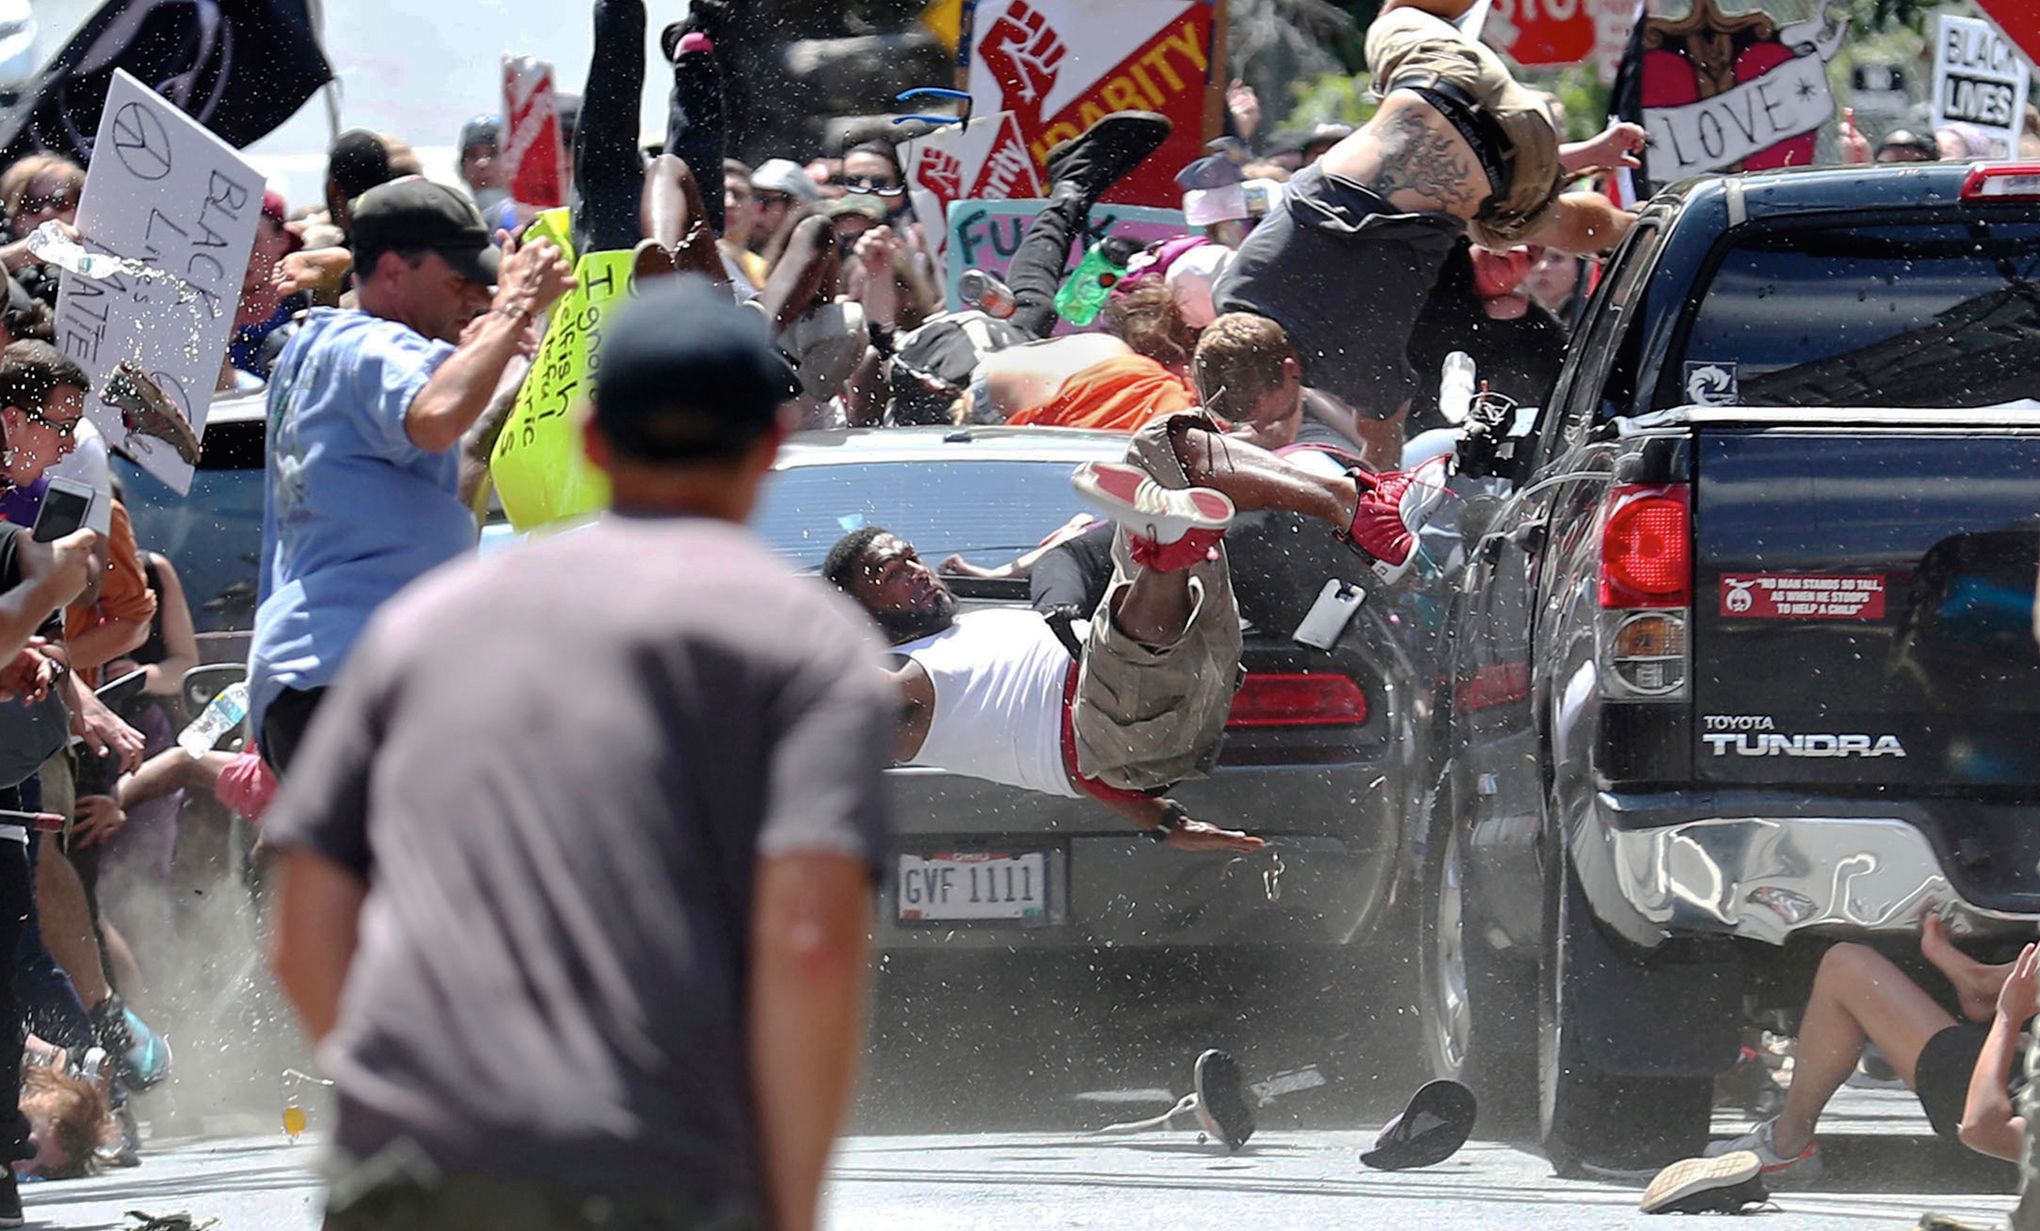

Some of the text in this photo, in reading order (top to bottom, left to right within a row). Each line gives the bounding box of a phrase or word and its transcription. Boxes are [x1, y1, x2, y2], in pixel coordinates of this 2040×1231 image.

[1944, 77, 2012, 125] LIVES
[1661, 79, 1798, 168] LOVE
[175, 170, 248, 319] BLACK
[957, 208, 1116, 265] FUK
[1770, 591, 1870, 603] AS WHEN HE STOOPS
[1803, 579, 1839, 590] STANDS
[1841, 579, 1855, 590] SO
[1777, 603, 1790, 614] TO
[1792, 604, 1818, 614] HELP
[1818, 604, 1826, 614] A
[1703, 715, 1775, 730] TOYOTA
[1702, 734, 1906, 757] TUNDRA
[905, 866, 1034, 904] GVF 1111
